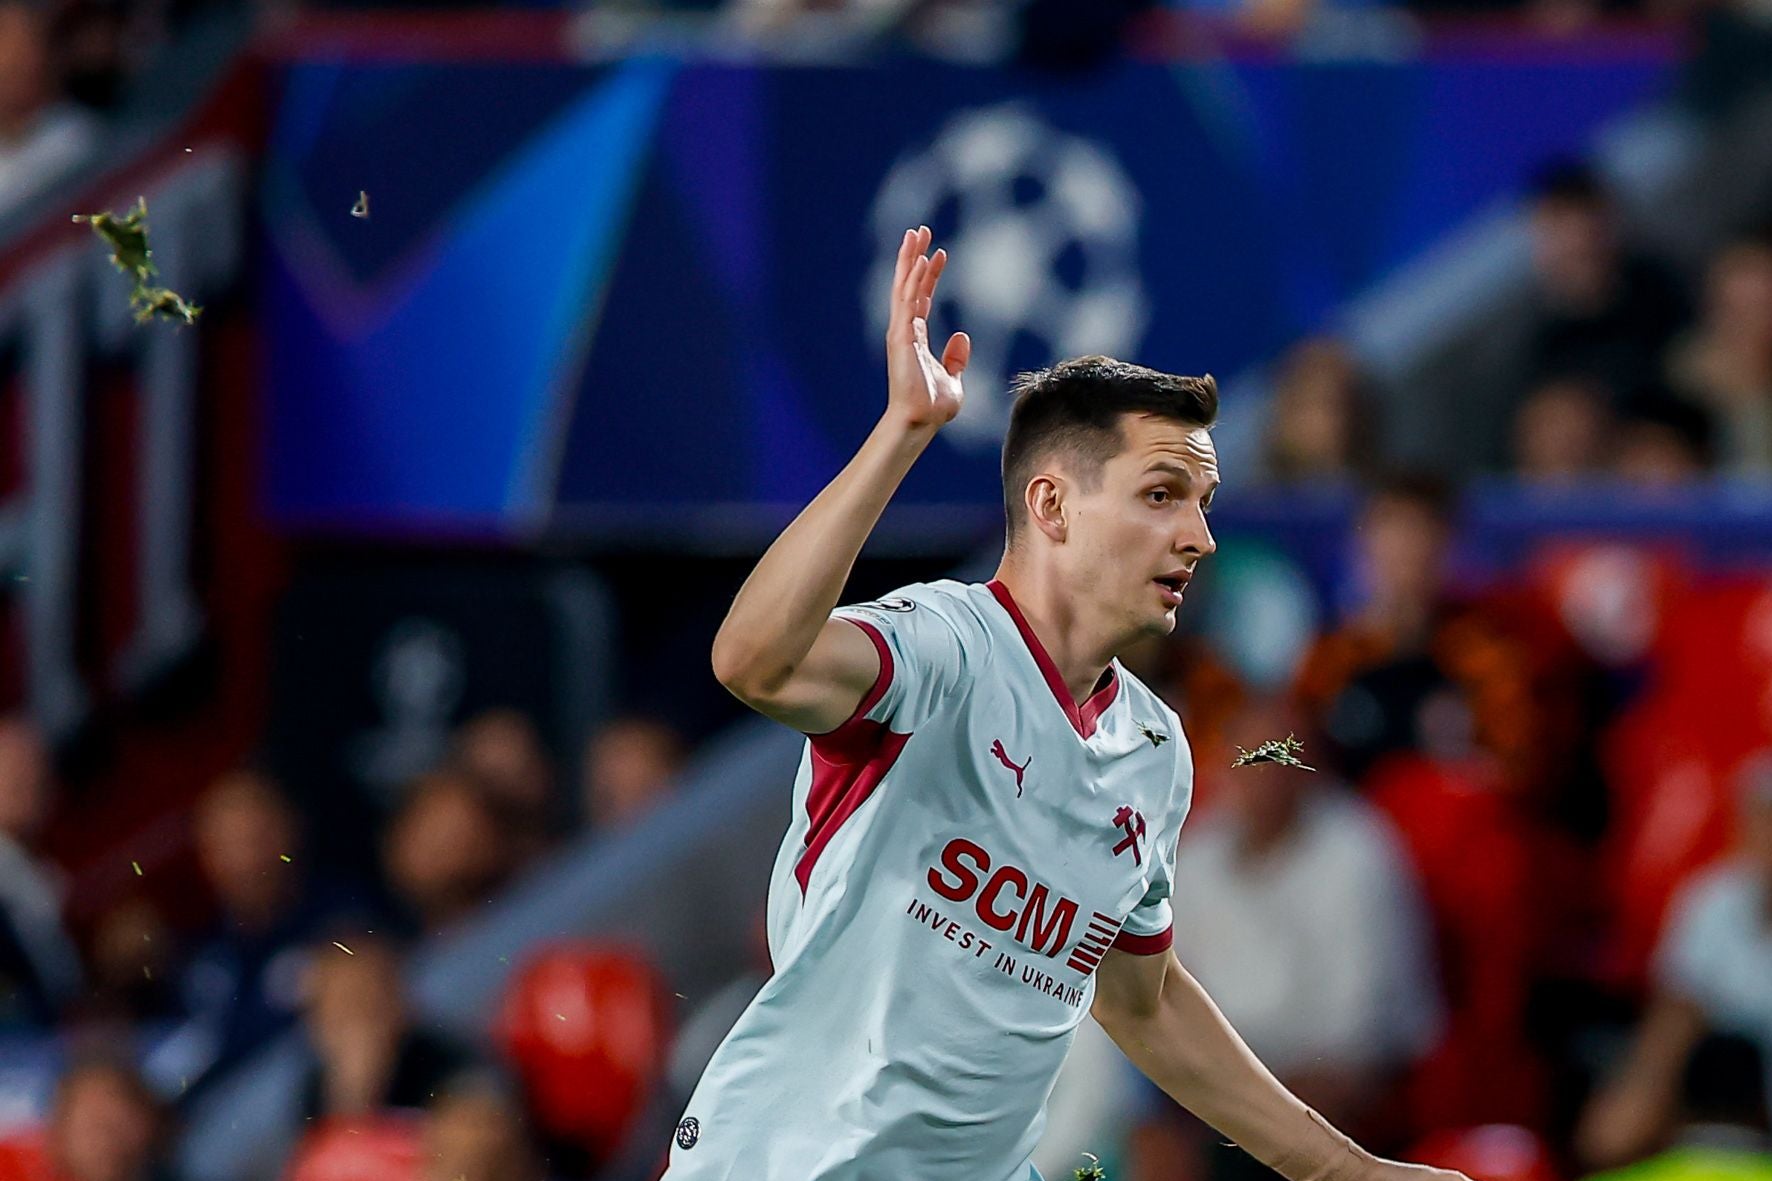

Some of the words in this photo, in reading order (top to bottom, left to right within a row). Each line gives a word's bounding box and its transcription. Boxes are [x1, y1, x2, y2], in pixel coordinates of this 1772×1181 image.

[907, 898, 992, 958] INVEST
[994, 952, 1016, 976] IN
[1022, 965, 1084, 1008] UKRAINE
[927, 838, 1079, 958] SCM
